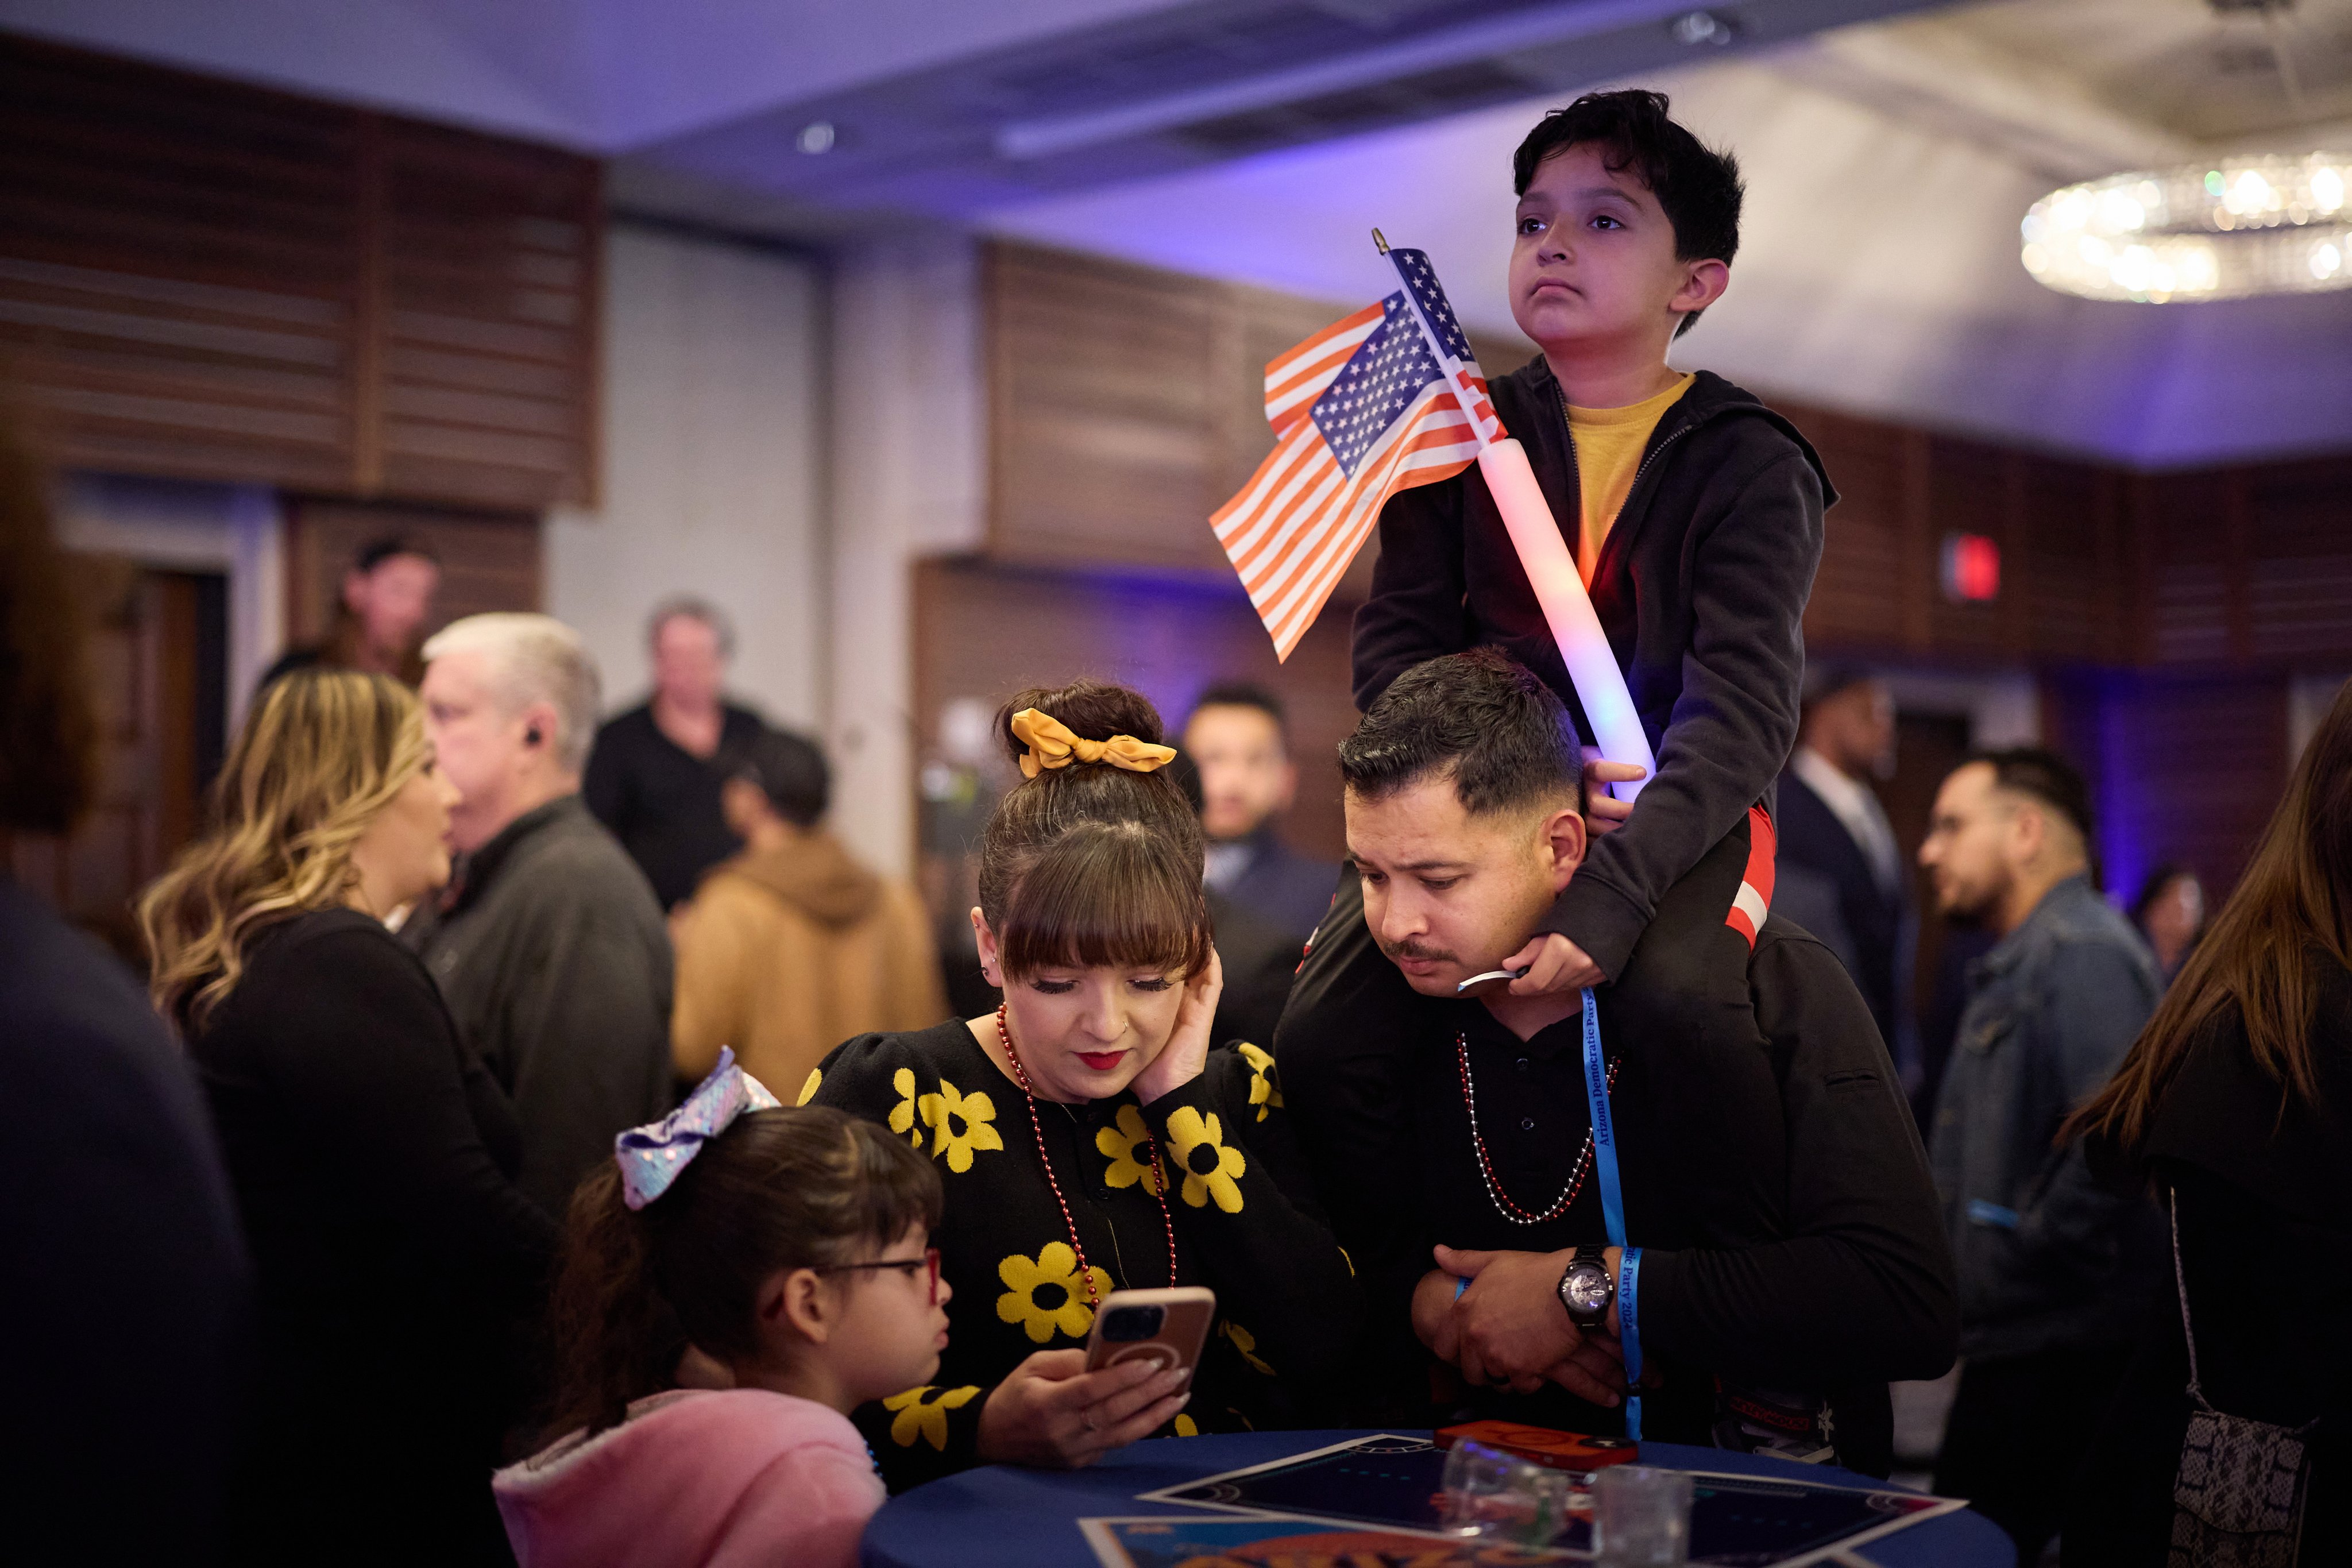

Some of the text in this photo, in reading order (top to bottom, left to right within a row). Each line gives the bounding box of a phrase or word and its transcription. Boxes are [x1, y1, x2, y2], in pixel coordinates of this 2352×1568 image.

[1586, 995, 1609, 1146] Arizona Democratic Party
[1620, 1267, 1633, 1299] Party
[1622, 1303, 1633, 1328] 2024
